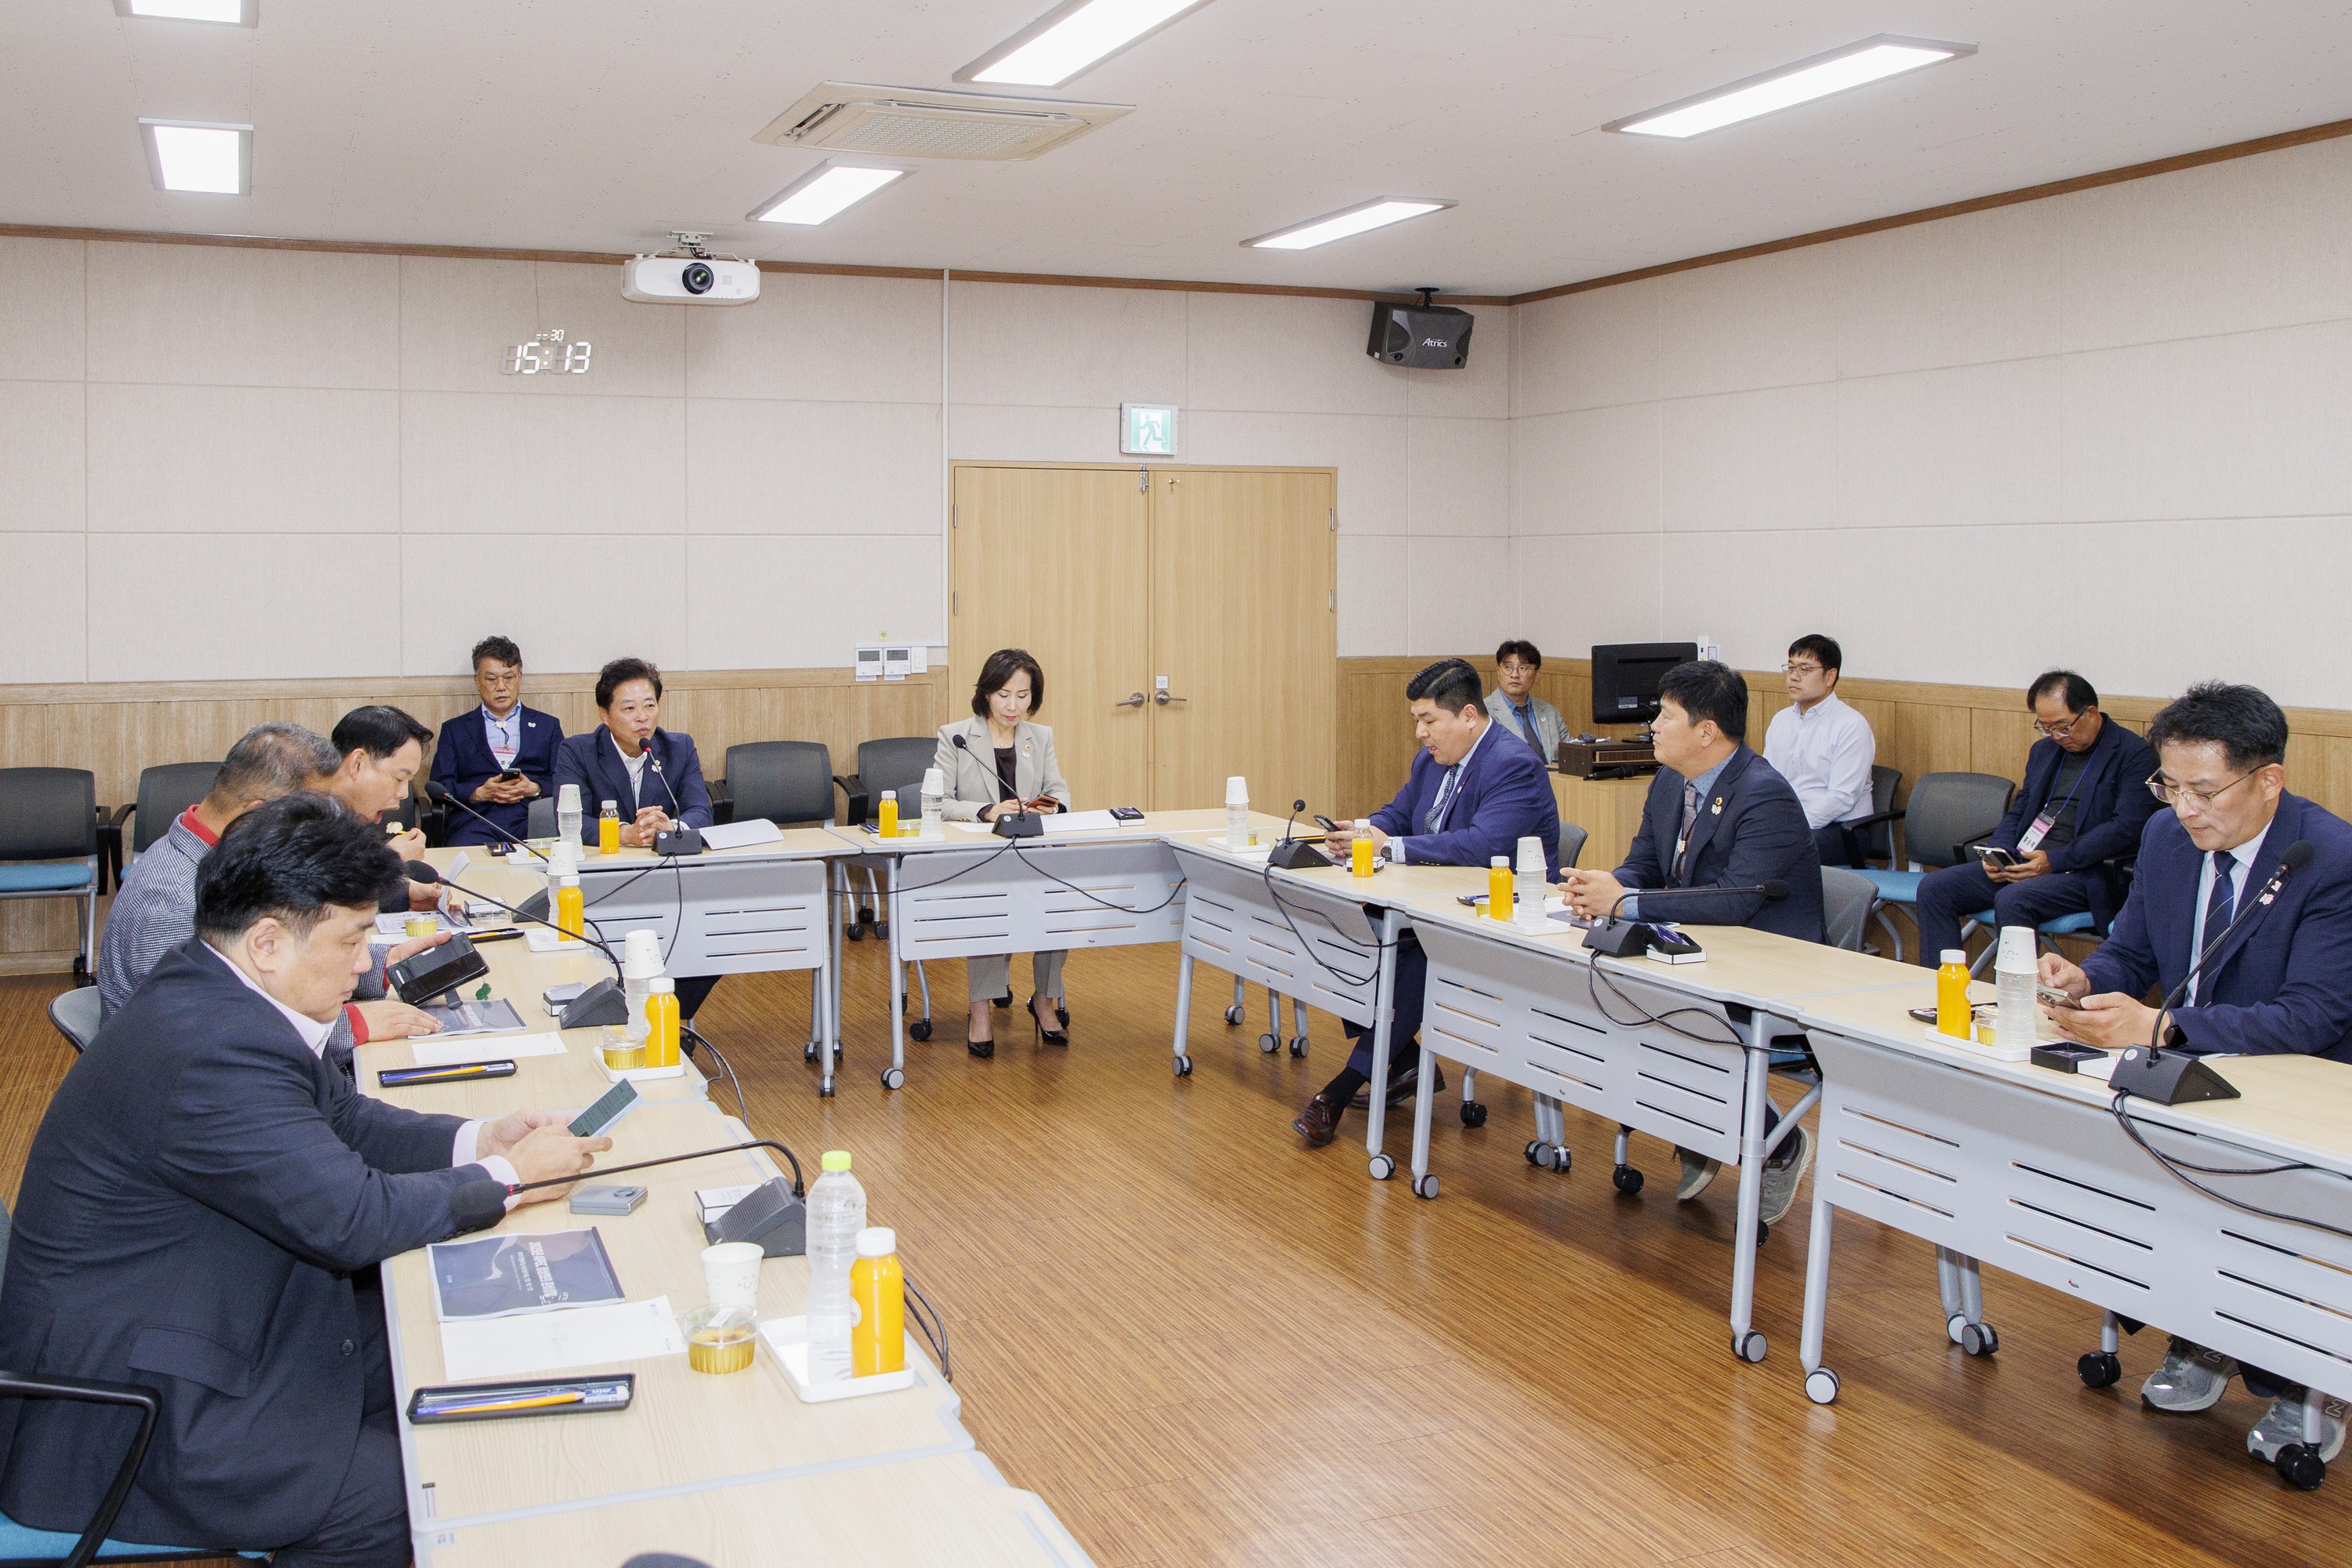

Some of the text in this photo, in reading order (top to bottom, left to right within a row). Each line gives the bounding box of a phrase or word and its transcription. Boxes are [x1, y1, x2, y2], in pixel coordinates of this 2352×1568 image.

[1421, 338, 1448, 347] Atrics
[514, 341, 592, 374] 15:13
[533, 1255, 548, 1267] APEC
